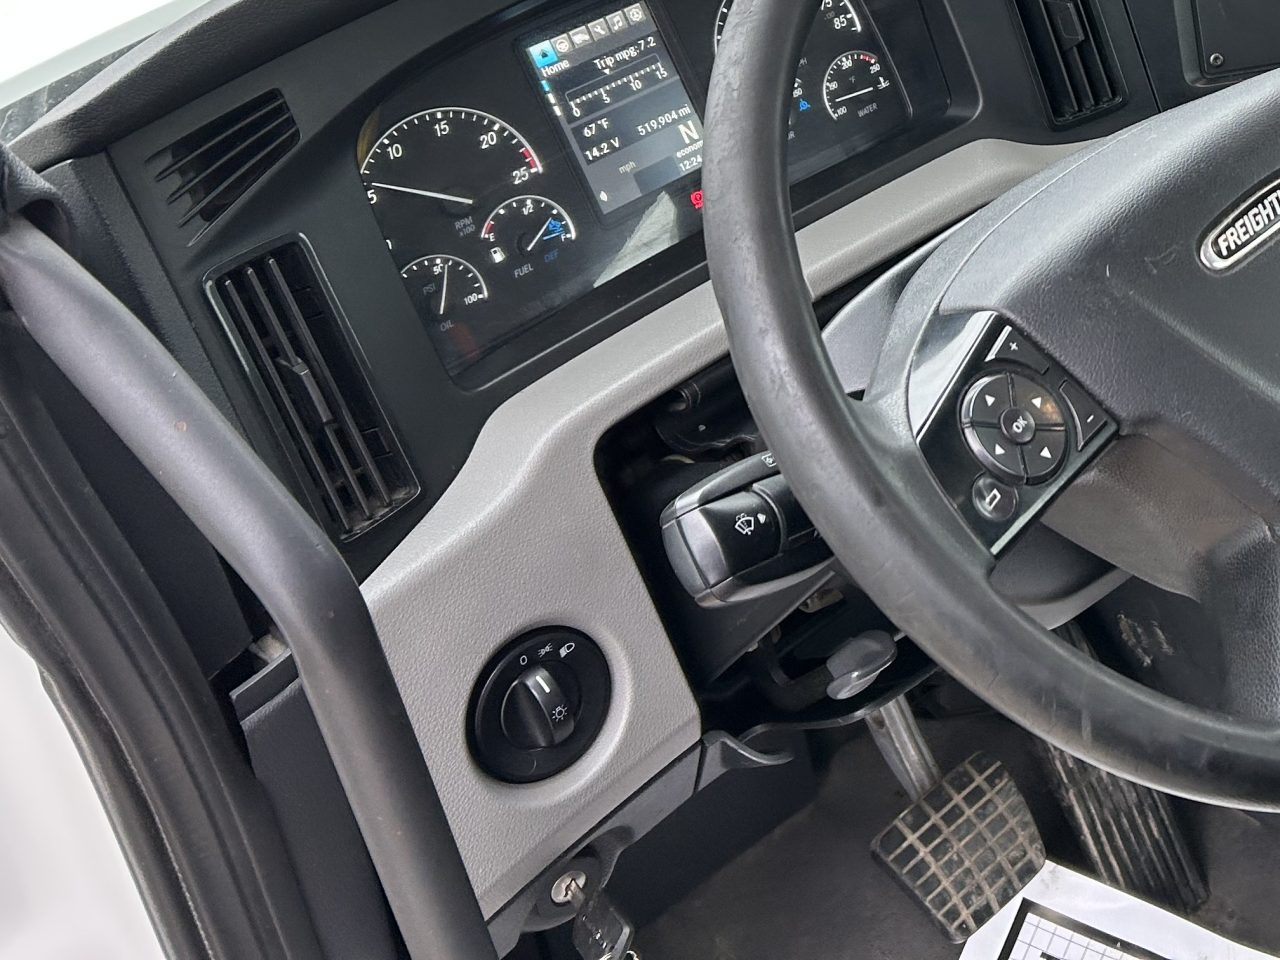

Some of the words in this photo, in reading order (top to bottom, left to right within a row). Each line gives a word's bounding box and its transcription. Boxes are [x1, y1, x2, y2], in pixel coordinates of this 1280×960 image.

[834, 16, 847, 30] 85
[592, 52, 615, 71] Trip
[615, 44, 640, 62] mpg:
[638, 36, 656, 52] 7.2
[540, 59, 570, 78] Home
[841, 60, 853, 70] 200
[870, 64, 880, 74] 250
[572, 107, 580, 118] 0
[603, 94, 611, 104] 5
[630, 80, 642, 91] 10
[656, 68, 668, 80] 15
[828, 81, 838, 90] 150
[837, 106, 847, 116] 100
[857, 103, 878, 118] WATER
[636, 111, 678, 136] 519,904
[678, 104, 691, 118] mi
[434, 121, 450, 137] 15
[583, 124, 596, 138] 67
[597, 118, 610, 130] °F
[678, 120, 700, 144] N
[480, 132, 497, 149] 20
[386, 143, 403, 160] 10
[584, 143, 609, 161] 14.2
[612, 137, 620, 149] V
[676, 139, 704, 158] econom
[618, 160, 636, 174] mph
[512, 167, 529, 185] 25
[367, 190, 377, 204] 5
[455, 216, 473, 231] RPM
[459, 224, 476, 238] x100
[489, 233, 496, 242] E
[544, 249, 559, 263] DEF
[514, 263, 534, 278] FUEL
[422, 283, 436, 295] PSI
[463, 293, 478, 305] 100
[440, 320, 454, 331] OIL
[1013, 416, 1028, 432] OK
